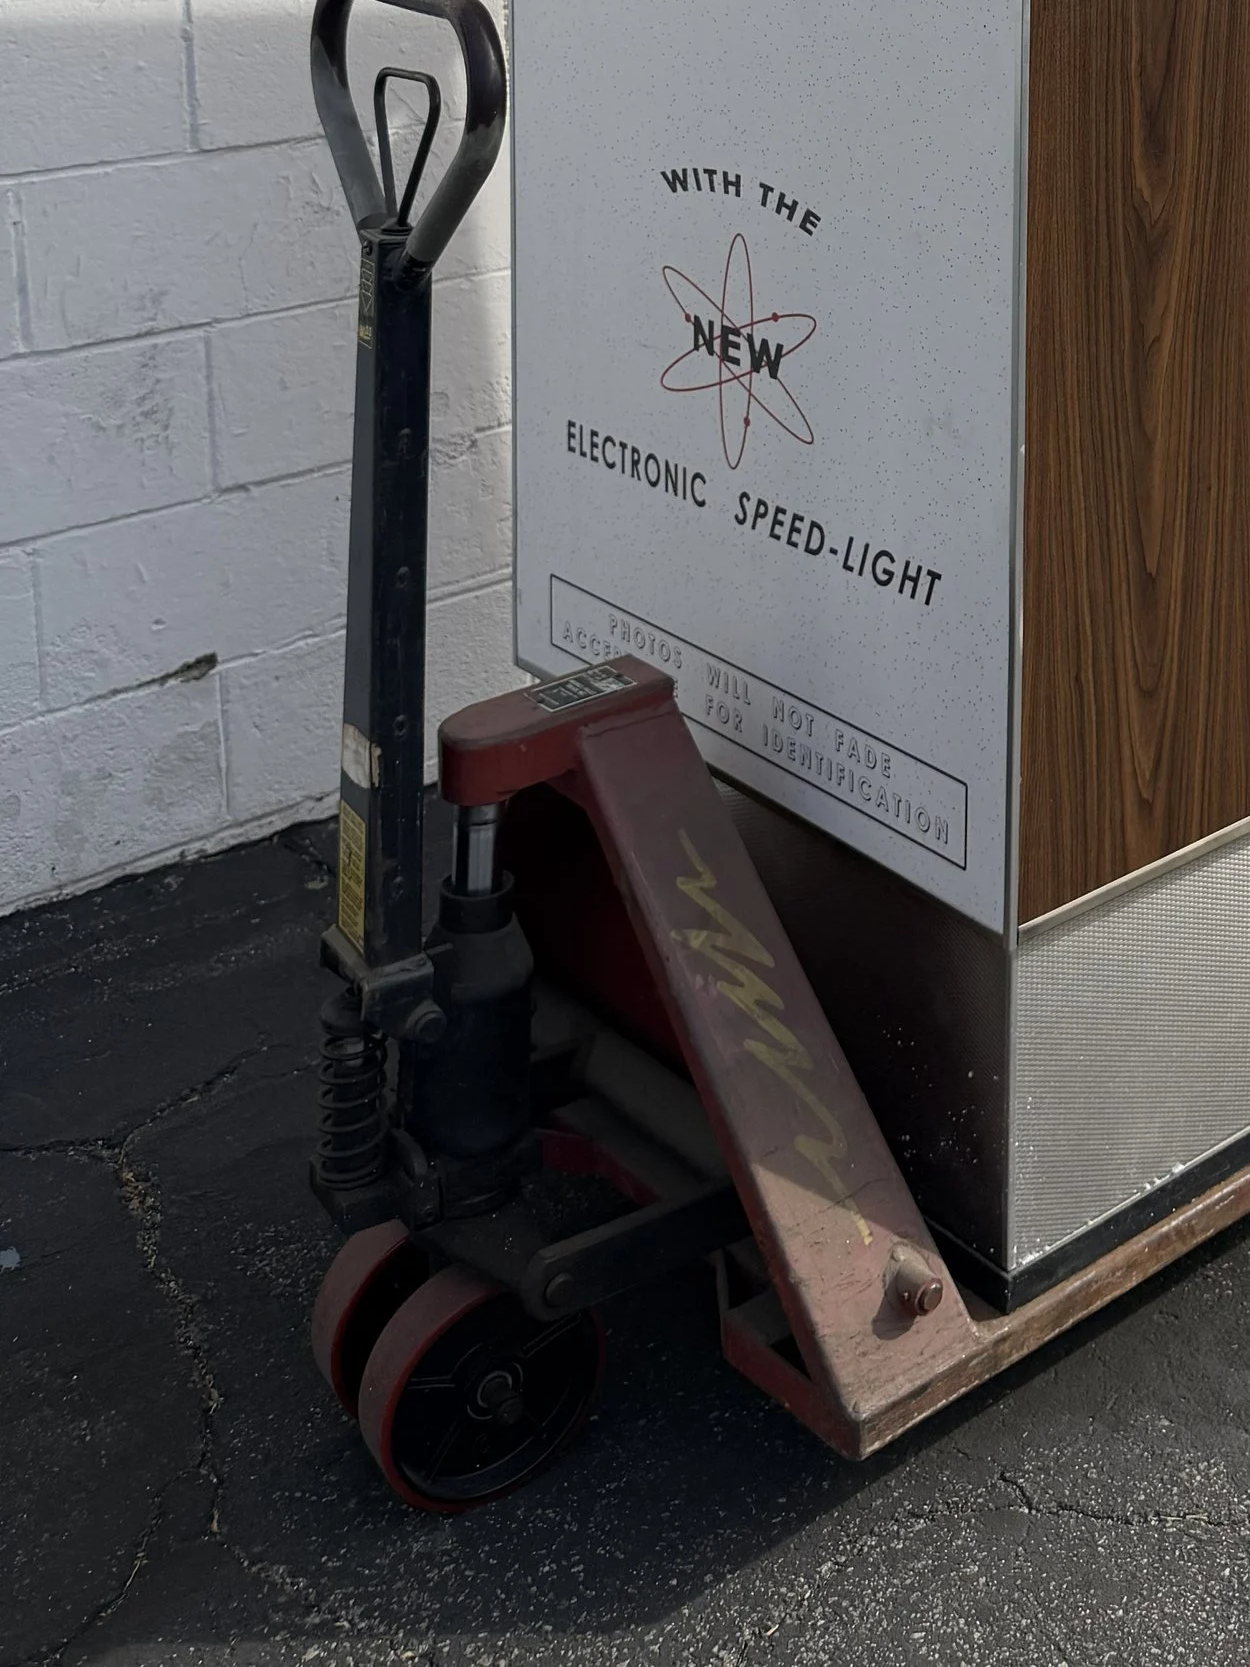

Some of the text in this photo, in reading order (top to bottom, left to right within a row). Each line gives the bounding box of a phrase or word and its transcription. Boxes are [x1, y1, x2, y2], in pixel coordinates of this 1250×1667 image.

[660, 167, 822, 236] WITH THE
[692, 315, 784, 380] NEW
[567, 420, 942, 606] ELECTRONIC SPEED-LIGHT
[608, 613, 892, 779] PHOTOS WILL NOT FADE
[705, 694, 743, 733] FOR
[762, 723, 949, 844] IDENTIFICATION
